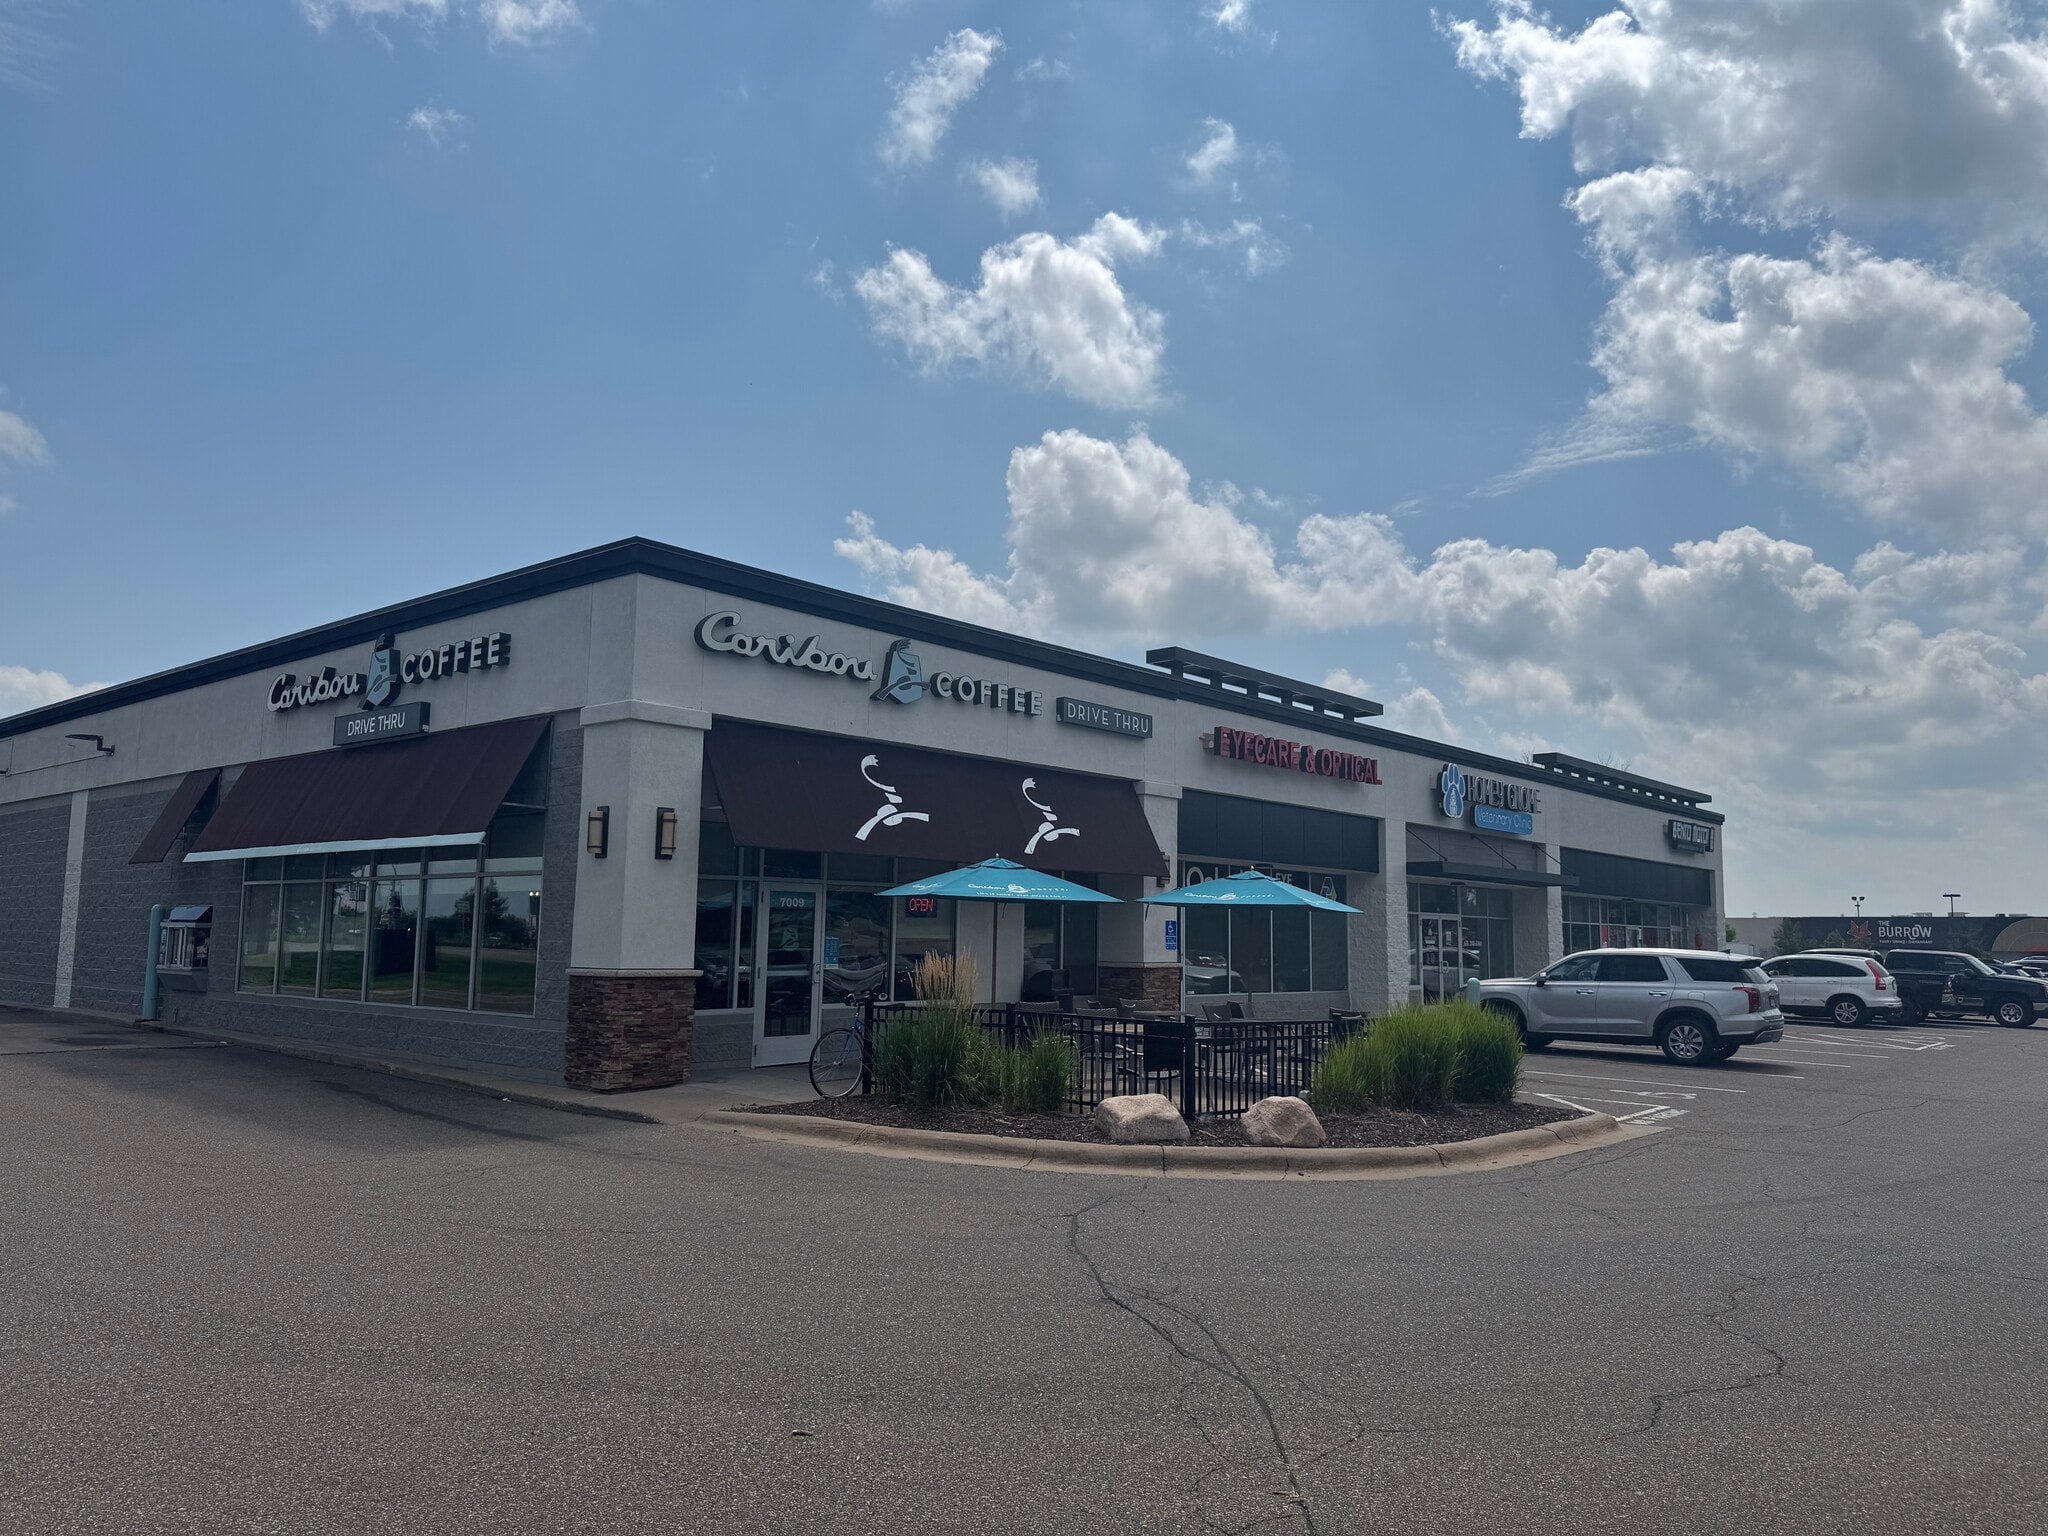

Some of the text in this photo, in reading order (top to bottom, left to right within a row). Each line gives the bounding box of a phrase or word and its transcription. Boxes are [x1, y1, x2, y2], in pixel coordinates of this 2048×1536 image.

[267, 632, 509, 712] Caribou COFFEE
[696, 611, 1042, 716] Caribou COFFEE
[347, 711, 406, 737] DRIVE THRU
[1067, 702, 1149, 733] DRIVE THRU
[1216, 727, 1382, 785] EYECARE & OPTICAL
[780, 897, 805, 908] 7009
[908, 897, 934, 912] OPEN
[1878, 924, 1932, 940] BURROW
